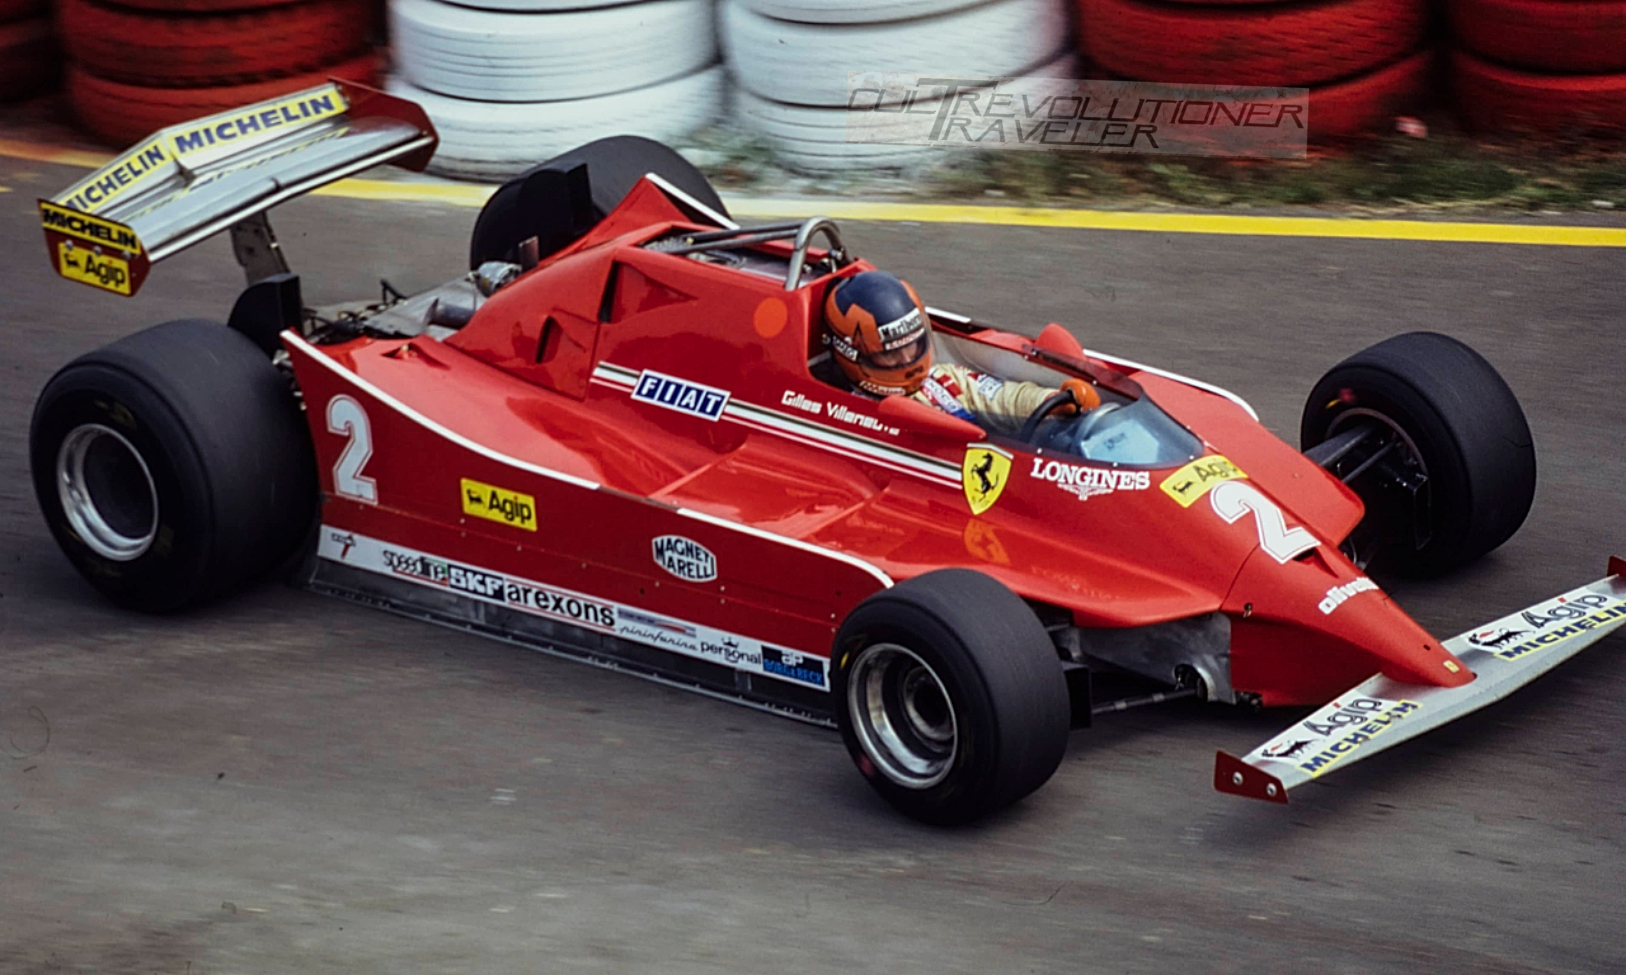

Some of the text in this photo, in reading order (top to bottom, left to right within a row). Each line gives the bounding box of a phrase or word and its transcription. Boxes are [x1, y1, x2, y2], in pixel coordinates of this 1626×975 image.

[174, 95, 335, 153] MICHELIN
[43, 208, 137, 248] MICHELIN
[85, 254, 125, 287] Agip
[641, 378, 721, 418] FIAT
[781, 390, 822, 414] Gilles
[326, 394, 378, 505] 2
[1030, 457, 1150, 490] LONGINES
[488, 489, 532, 524] Agip
[1210, 481, 1321, 564] 2
[449, 567, 503, 596] SKF
[507, 583, 615, 627] arexons
[1521, 595, 1608, 629] Agip
[700, 641, 761, 664] personal
[1302, 699, 1382, 737] Agip
